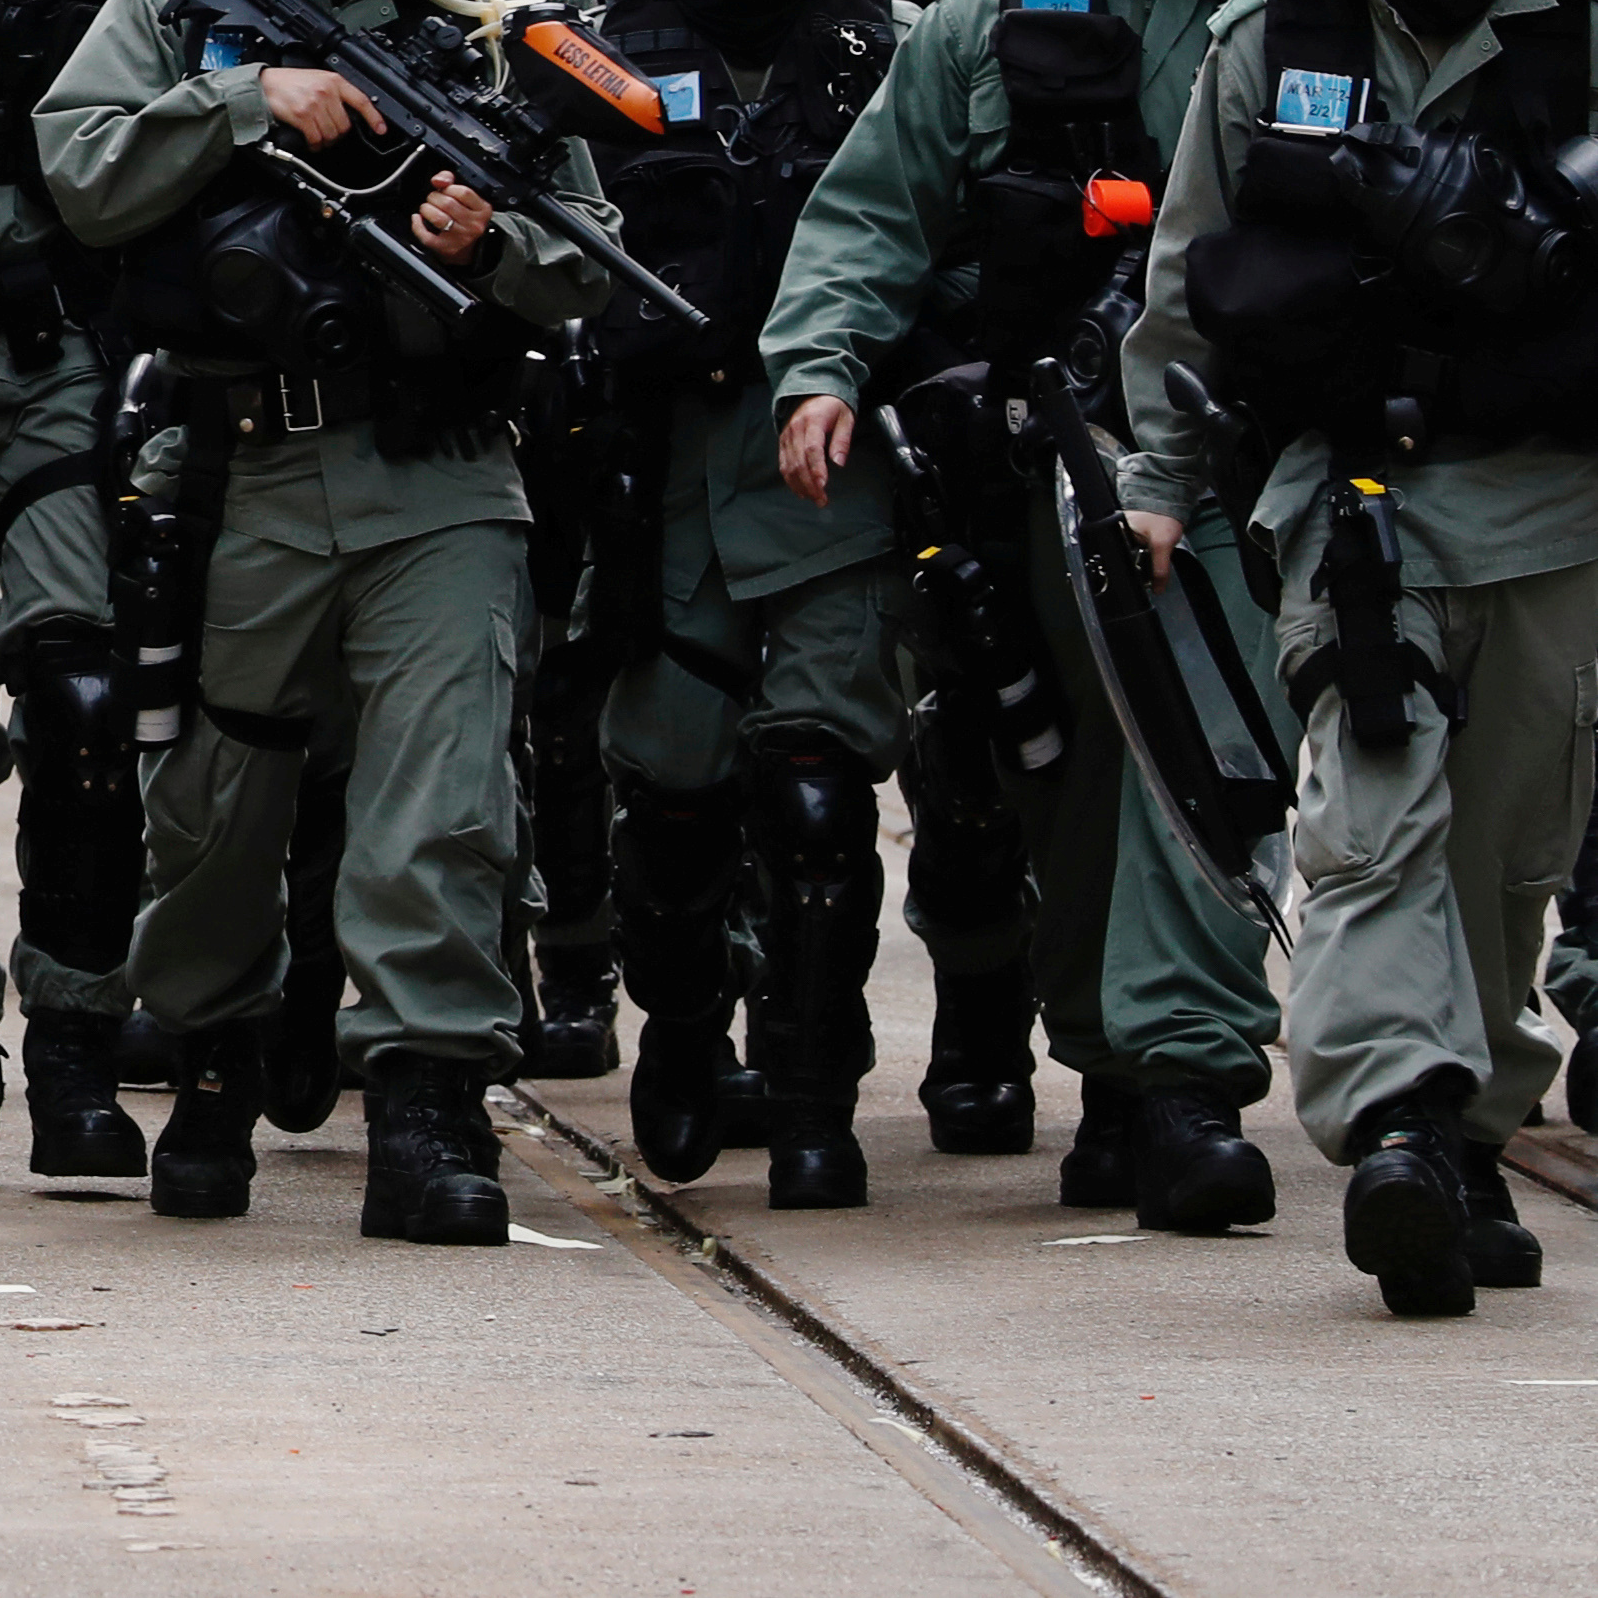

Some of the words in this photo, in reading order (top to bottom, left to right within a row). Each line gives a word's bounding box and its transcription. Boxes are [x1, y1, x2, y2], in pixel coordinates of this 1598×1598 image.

[555, 38, 590, 69] LESS
[582, 58, 631, 100] LETHAL
[1309, 104, 1331, 118] 2/2
